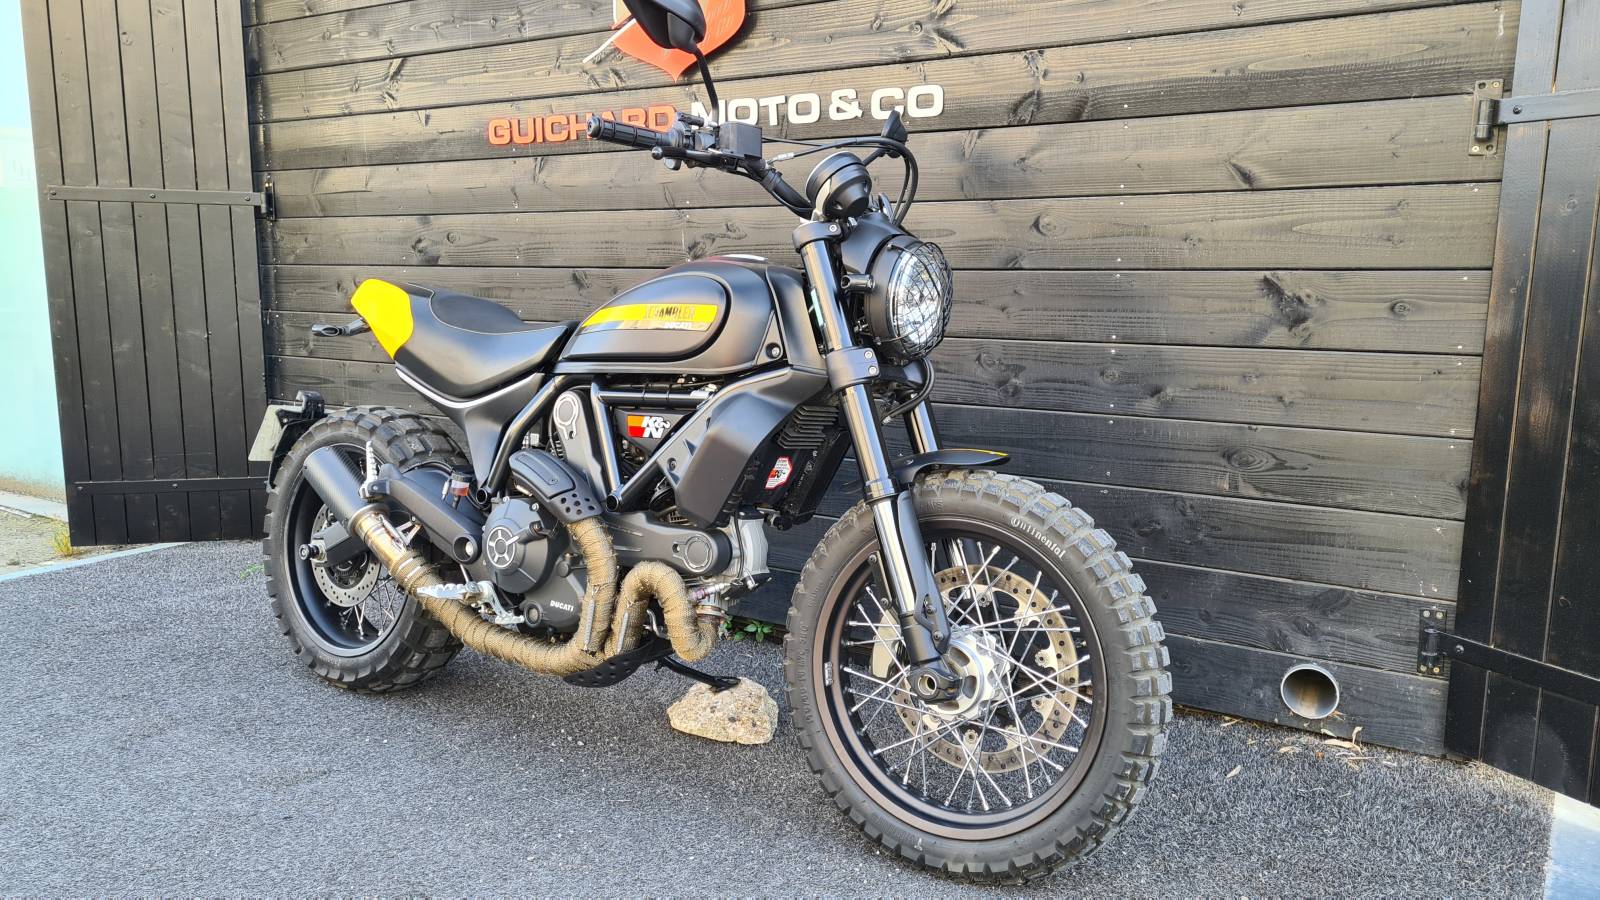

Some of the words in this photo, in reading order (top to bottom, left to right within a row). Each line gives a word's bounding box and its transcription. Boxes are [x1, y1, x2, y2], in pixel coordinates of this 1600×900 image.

[828, 88, 863, 121] &
[870, 84, 944, 121] CO
[550, 599, 575, 612] DUCATI
